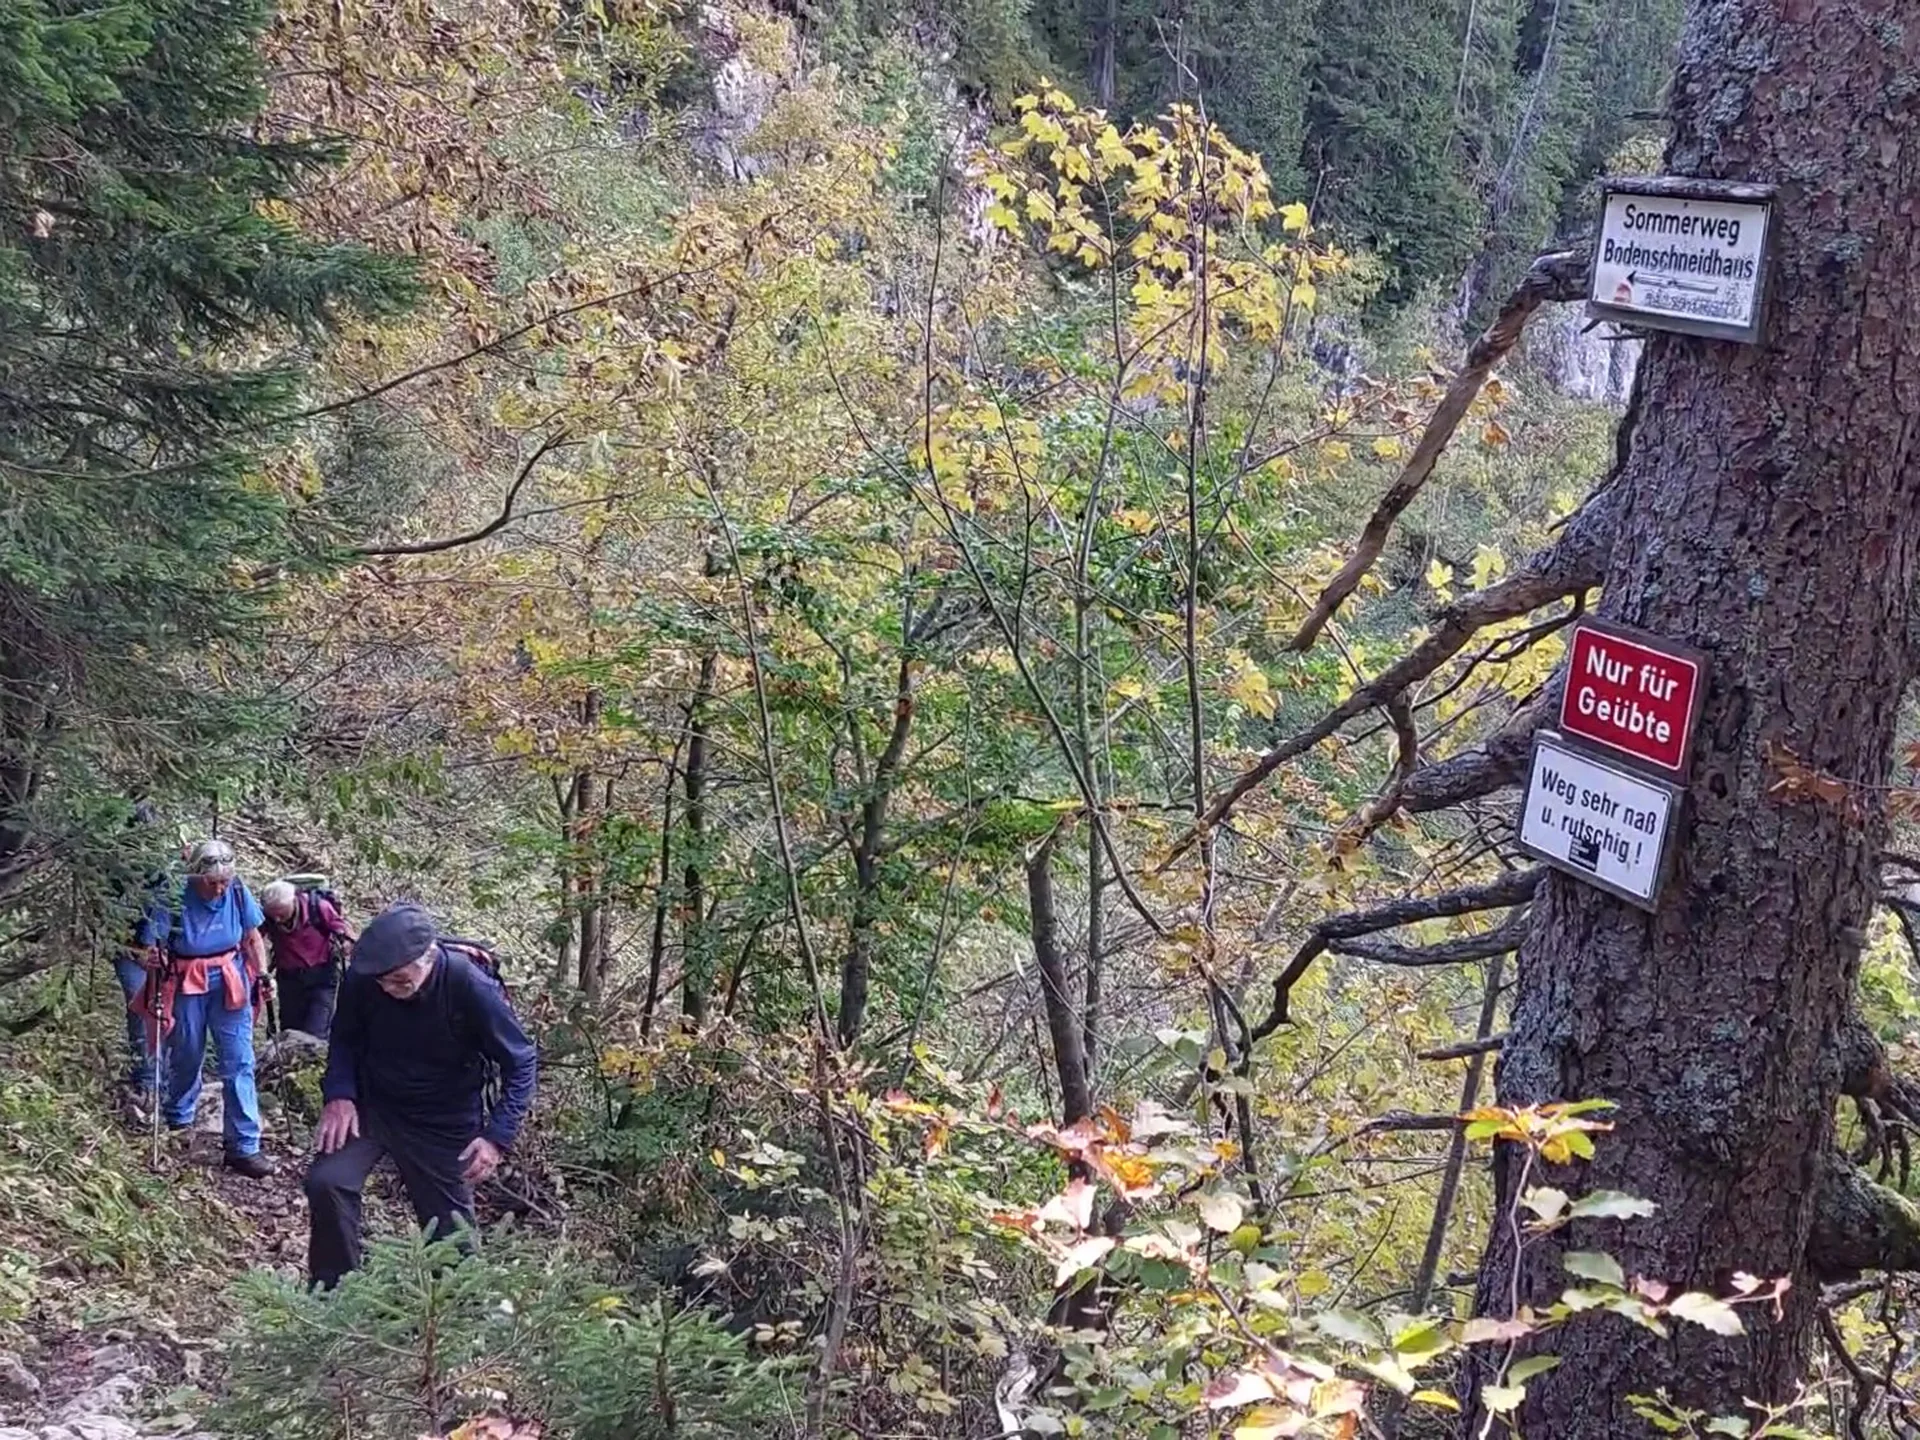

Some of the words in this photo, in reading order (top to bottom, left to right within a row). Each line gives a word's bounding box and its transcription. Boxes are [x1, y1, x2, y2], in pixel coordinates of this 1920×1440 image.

[1623, 203, 1741, 247] Sommerweg
[1603, 238, 1755, 279] Bodenschneidhaus
[1586, 645, 1634, 686] Nur
[1638, 664, 1679, 702] für
[1577, 685, 1671, 744] Geübte
[1541, 766, 1577, 806] Weg
[1580, 786, 1620, 819] sehr
[1623, 806, 1657, 836] naß
[1541, 805, 1556, 828] u.
[1561, 814, 1630, 864] rutschig
